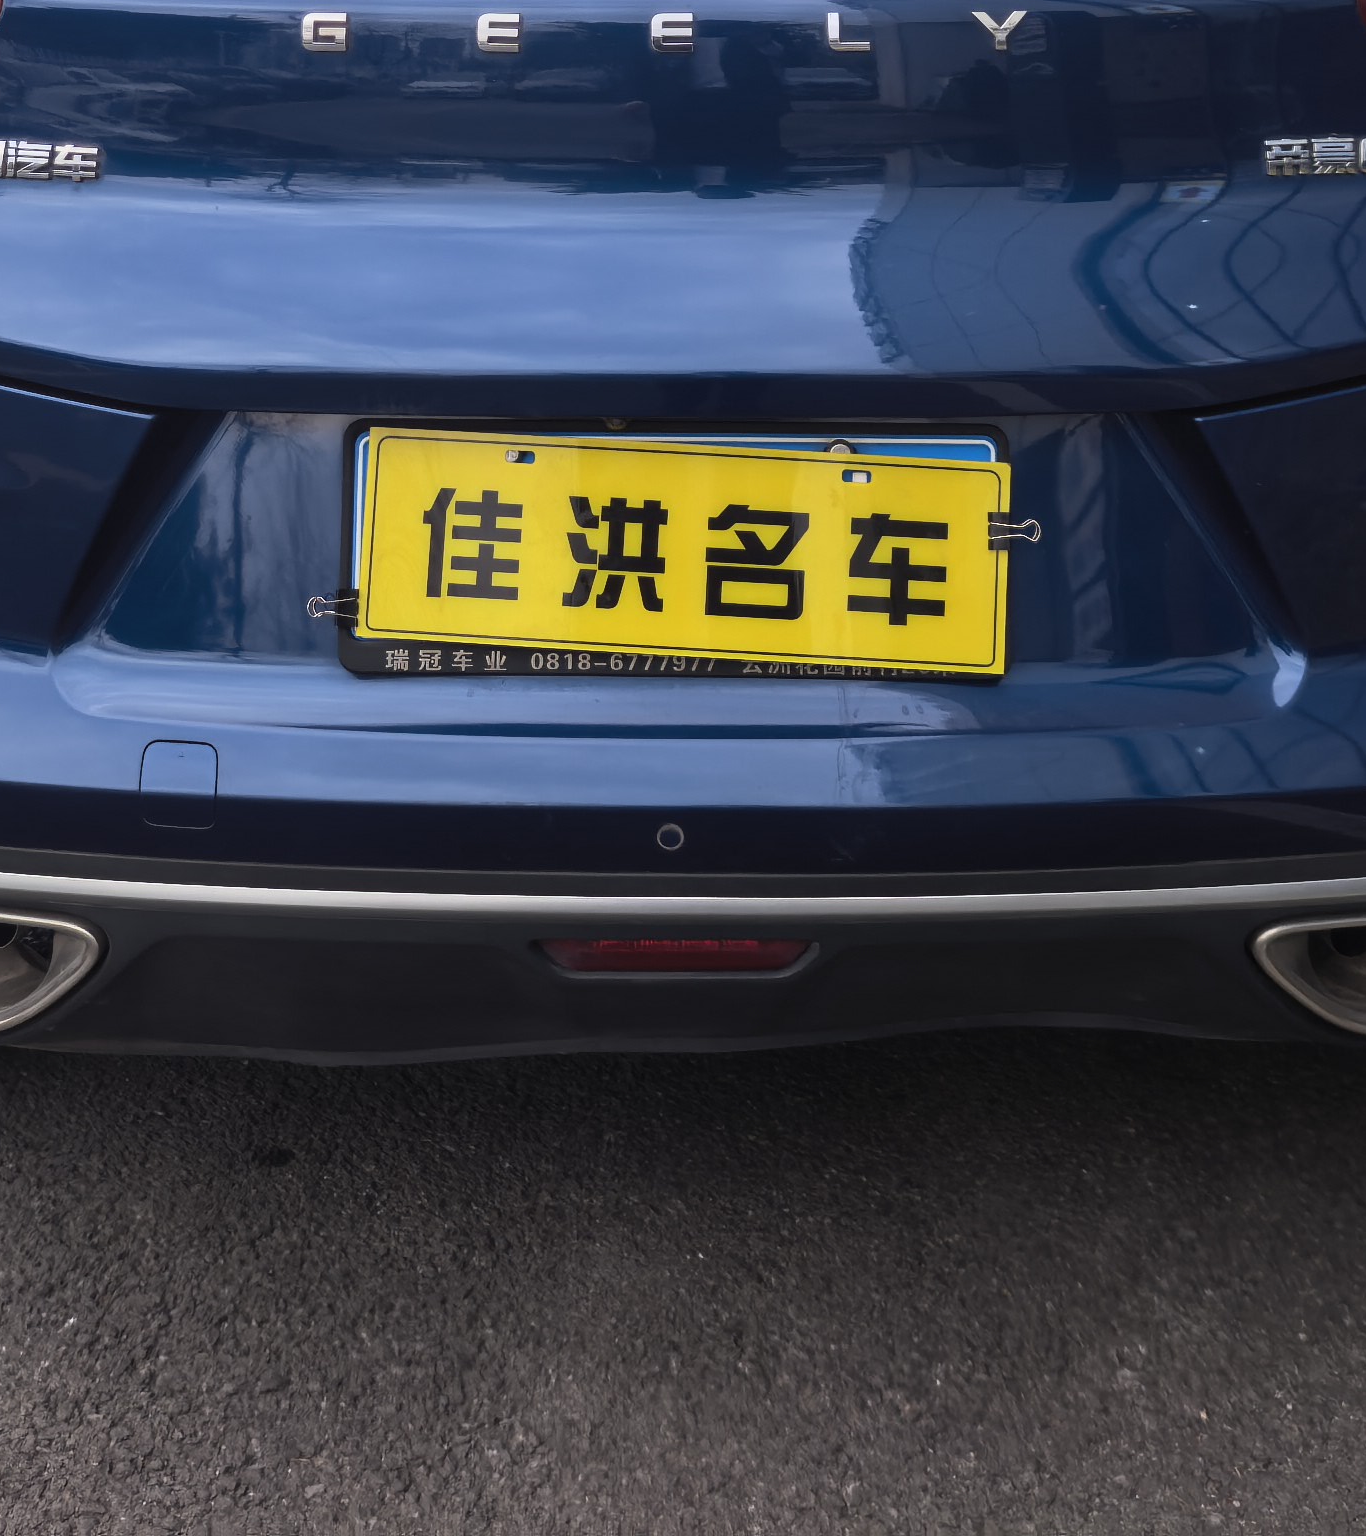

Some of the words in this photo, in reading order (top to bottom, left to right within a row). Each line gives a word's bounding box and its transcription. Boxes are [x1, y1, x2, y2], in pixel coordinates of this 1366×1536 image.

[300, 10, 1028, 53] GEELY
[422, 487, 949, 627] 佳洪名车
[385, 648, 508, 672] 瑞冠车业
[530, 652, 717, 672] 0818-6777977
